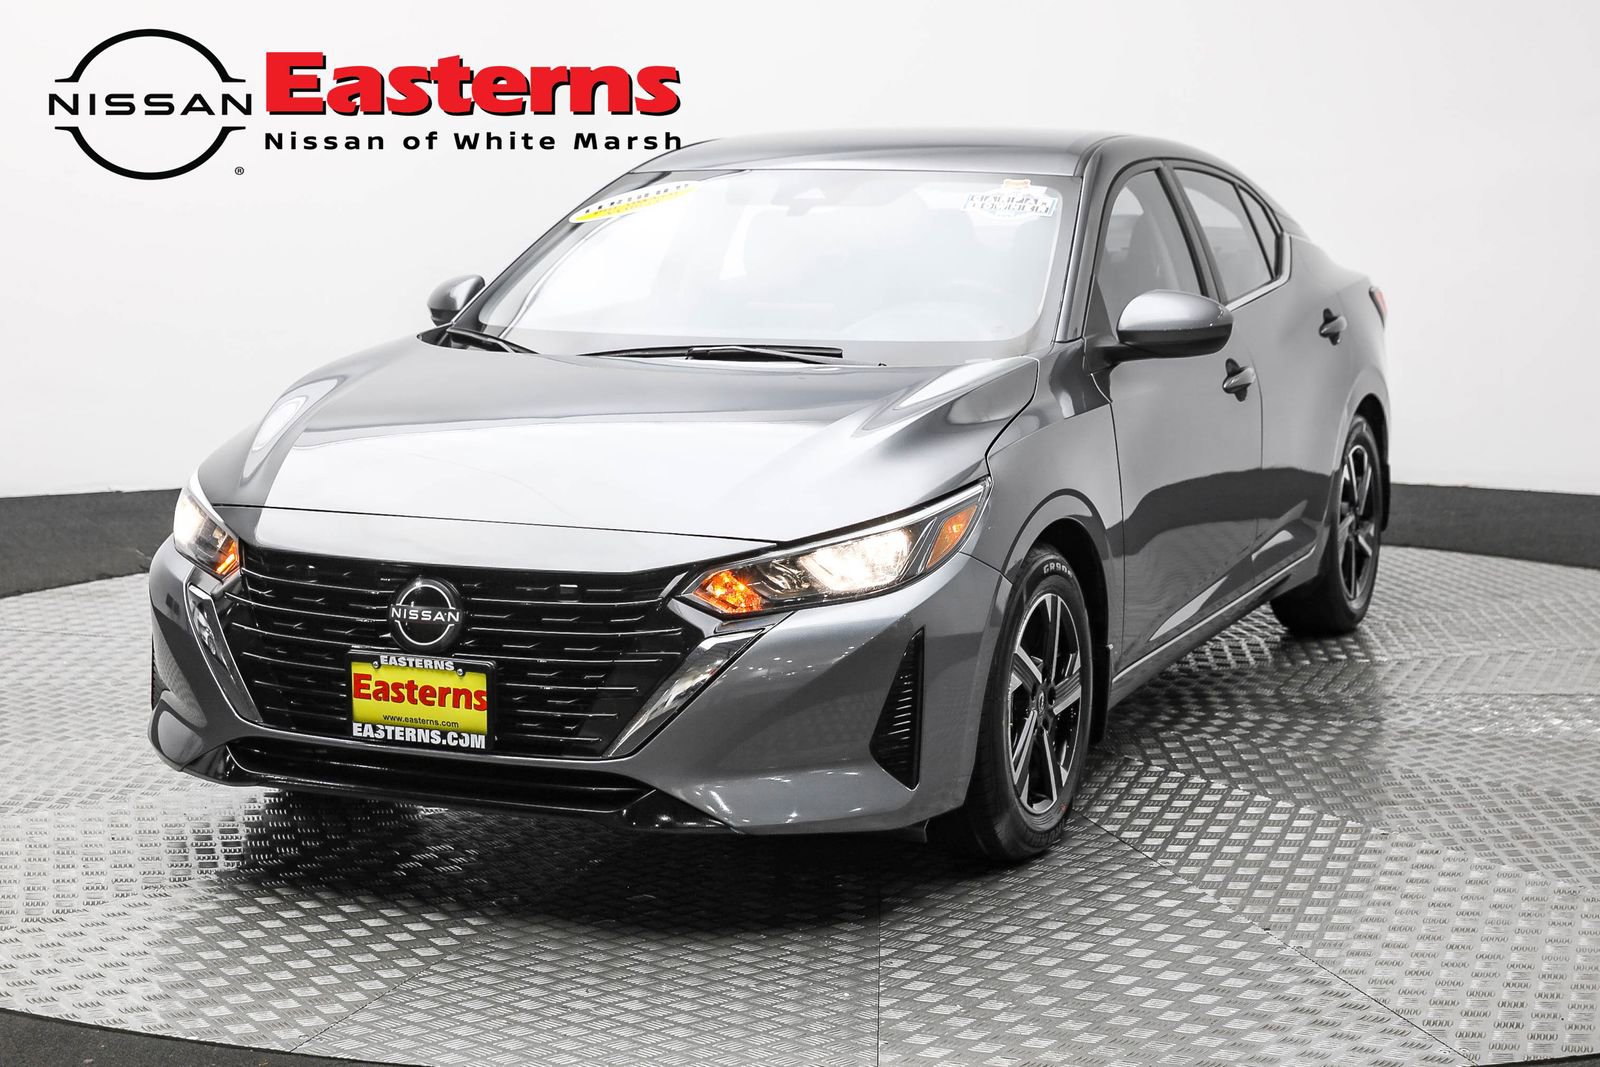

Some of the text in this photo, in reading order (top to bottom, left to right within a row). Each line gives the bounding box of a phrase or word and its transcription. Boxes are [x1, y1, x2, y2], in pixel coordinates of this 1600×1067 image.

[391, 608, 460, 622] NISSAN
[380, 655, 455, 671] EASTERNS
[353, 672, 487, 711] Easterns
[382, 713, 459, 728] www.easterns.com
[352, 722, 486, 749] EASTERNS.COM
